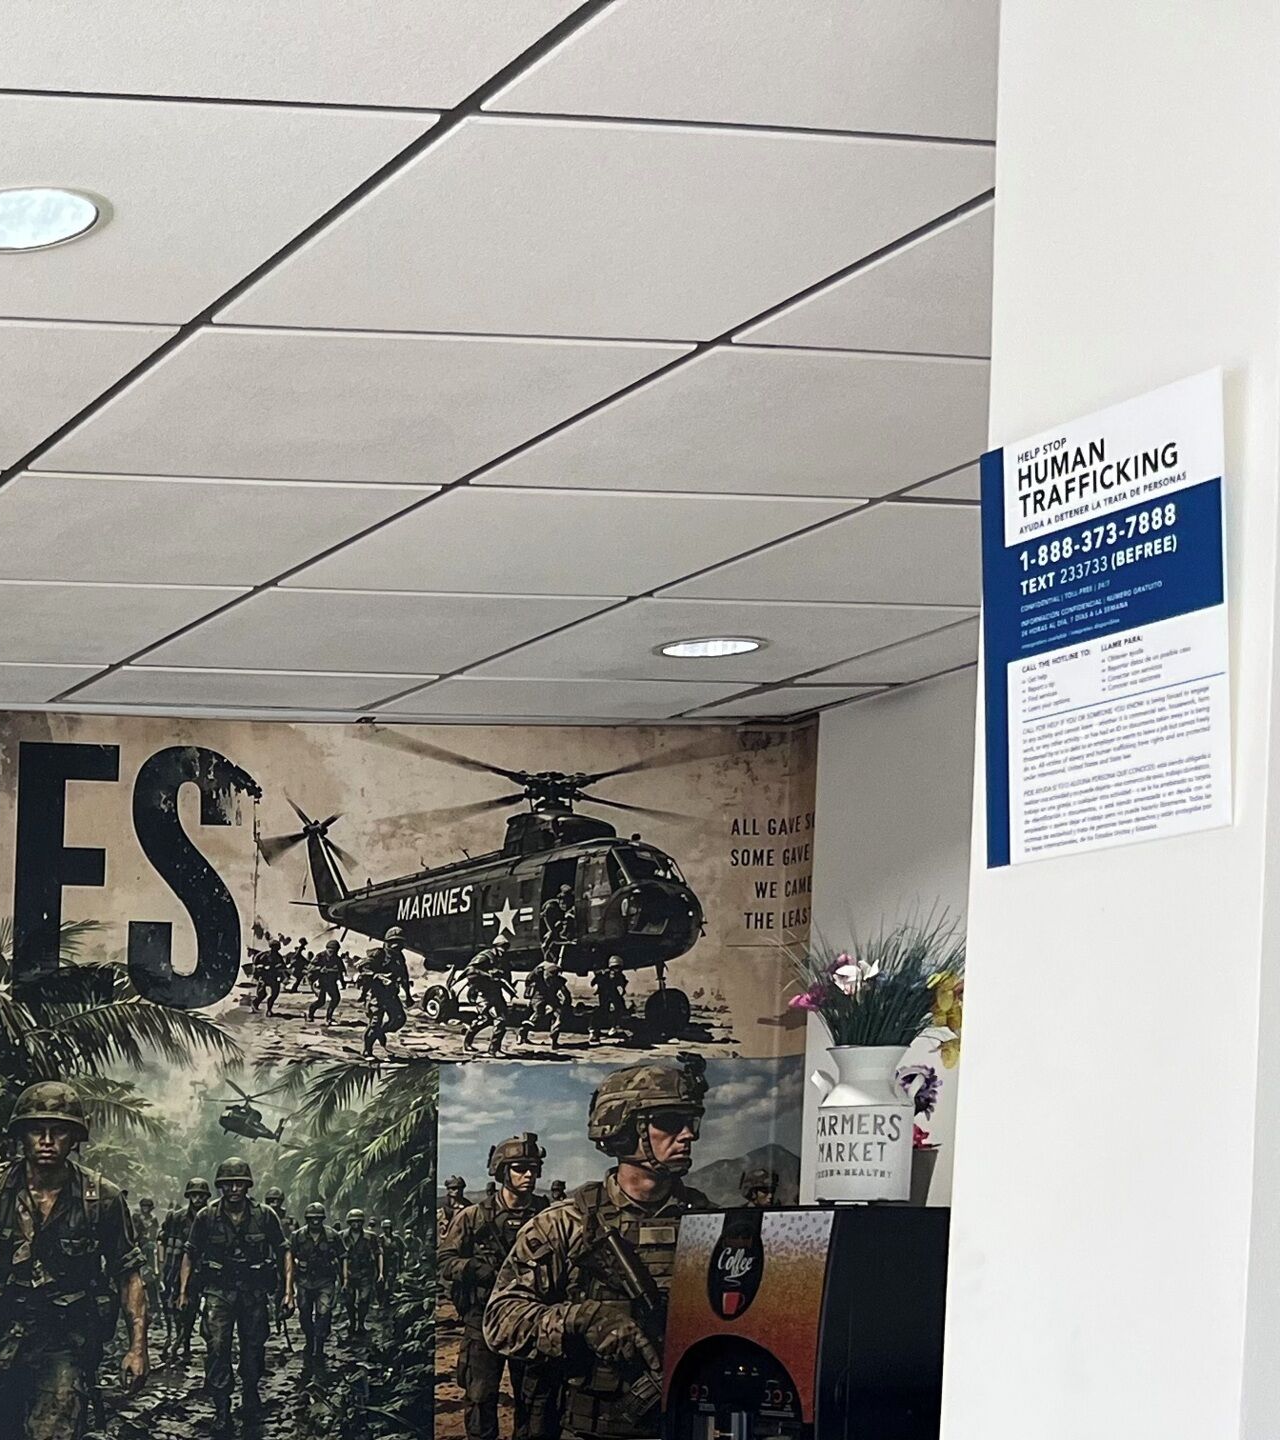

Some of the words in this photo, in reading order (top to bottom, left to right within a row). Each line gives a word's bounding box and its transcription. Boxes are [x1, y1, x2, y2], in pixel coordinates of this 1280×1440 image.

[1017, 447, 1039, 464] HELP
[1043, 437, 1066, 454] STOP
[1018, 438, 1104, 491] HUMAN
[1019, 442, 1177, 519] TRAFFICKING
[1019, 520, 1044, 535] AYUDA
[1047, 517, 1052, 525] A
[1055, 504, 1088, 523] DETENER
[1091, 500, 1101, 510] LA
[1103, 492, 1127, 507] TRATA
[1130, 487, 1140, 497] DE
[1143, 471, 1186, 493] PERSONAS
[1019, 502, 1176, 572] 1-888-373-7888
[1020, 572, 1055, 596] TEXT
[1060, 556, 1107, 583] 233733
[1111, 534, 1177, 570] (BEFREE)
[1101, 641, 1120, 652] LLAME
[1022, 664, 1036, 673] CALL
[1039, 660, 1049, 668] THE
[1052, 652, 1078, 664] HOTLINE
[731, 818, 760, 836] ALL
[768, 816, 801, 836] GAVE
[730, 849, 774, 866] SOME
[782, 844, 810, 866] GAVE
[755, 881, 778, 898] WE
[784, 876, 812, 898] CAME
[397, 885, 473, 921] MARINES
[744, 912, 774, 929] THE
[844, 1168, 892, 1178] HEALTHY
[718, 1247, 754, 1277] Coffee
